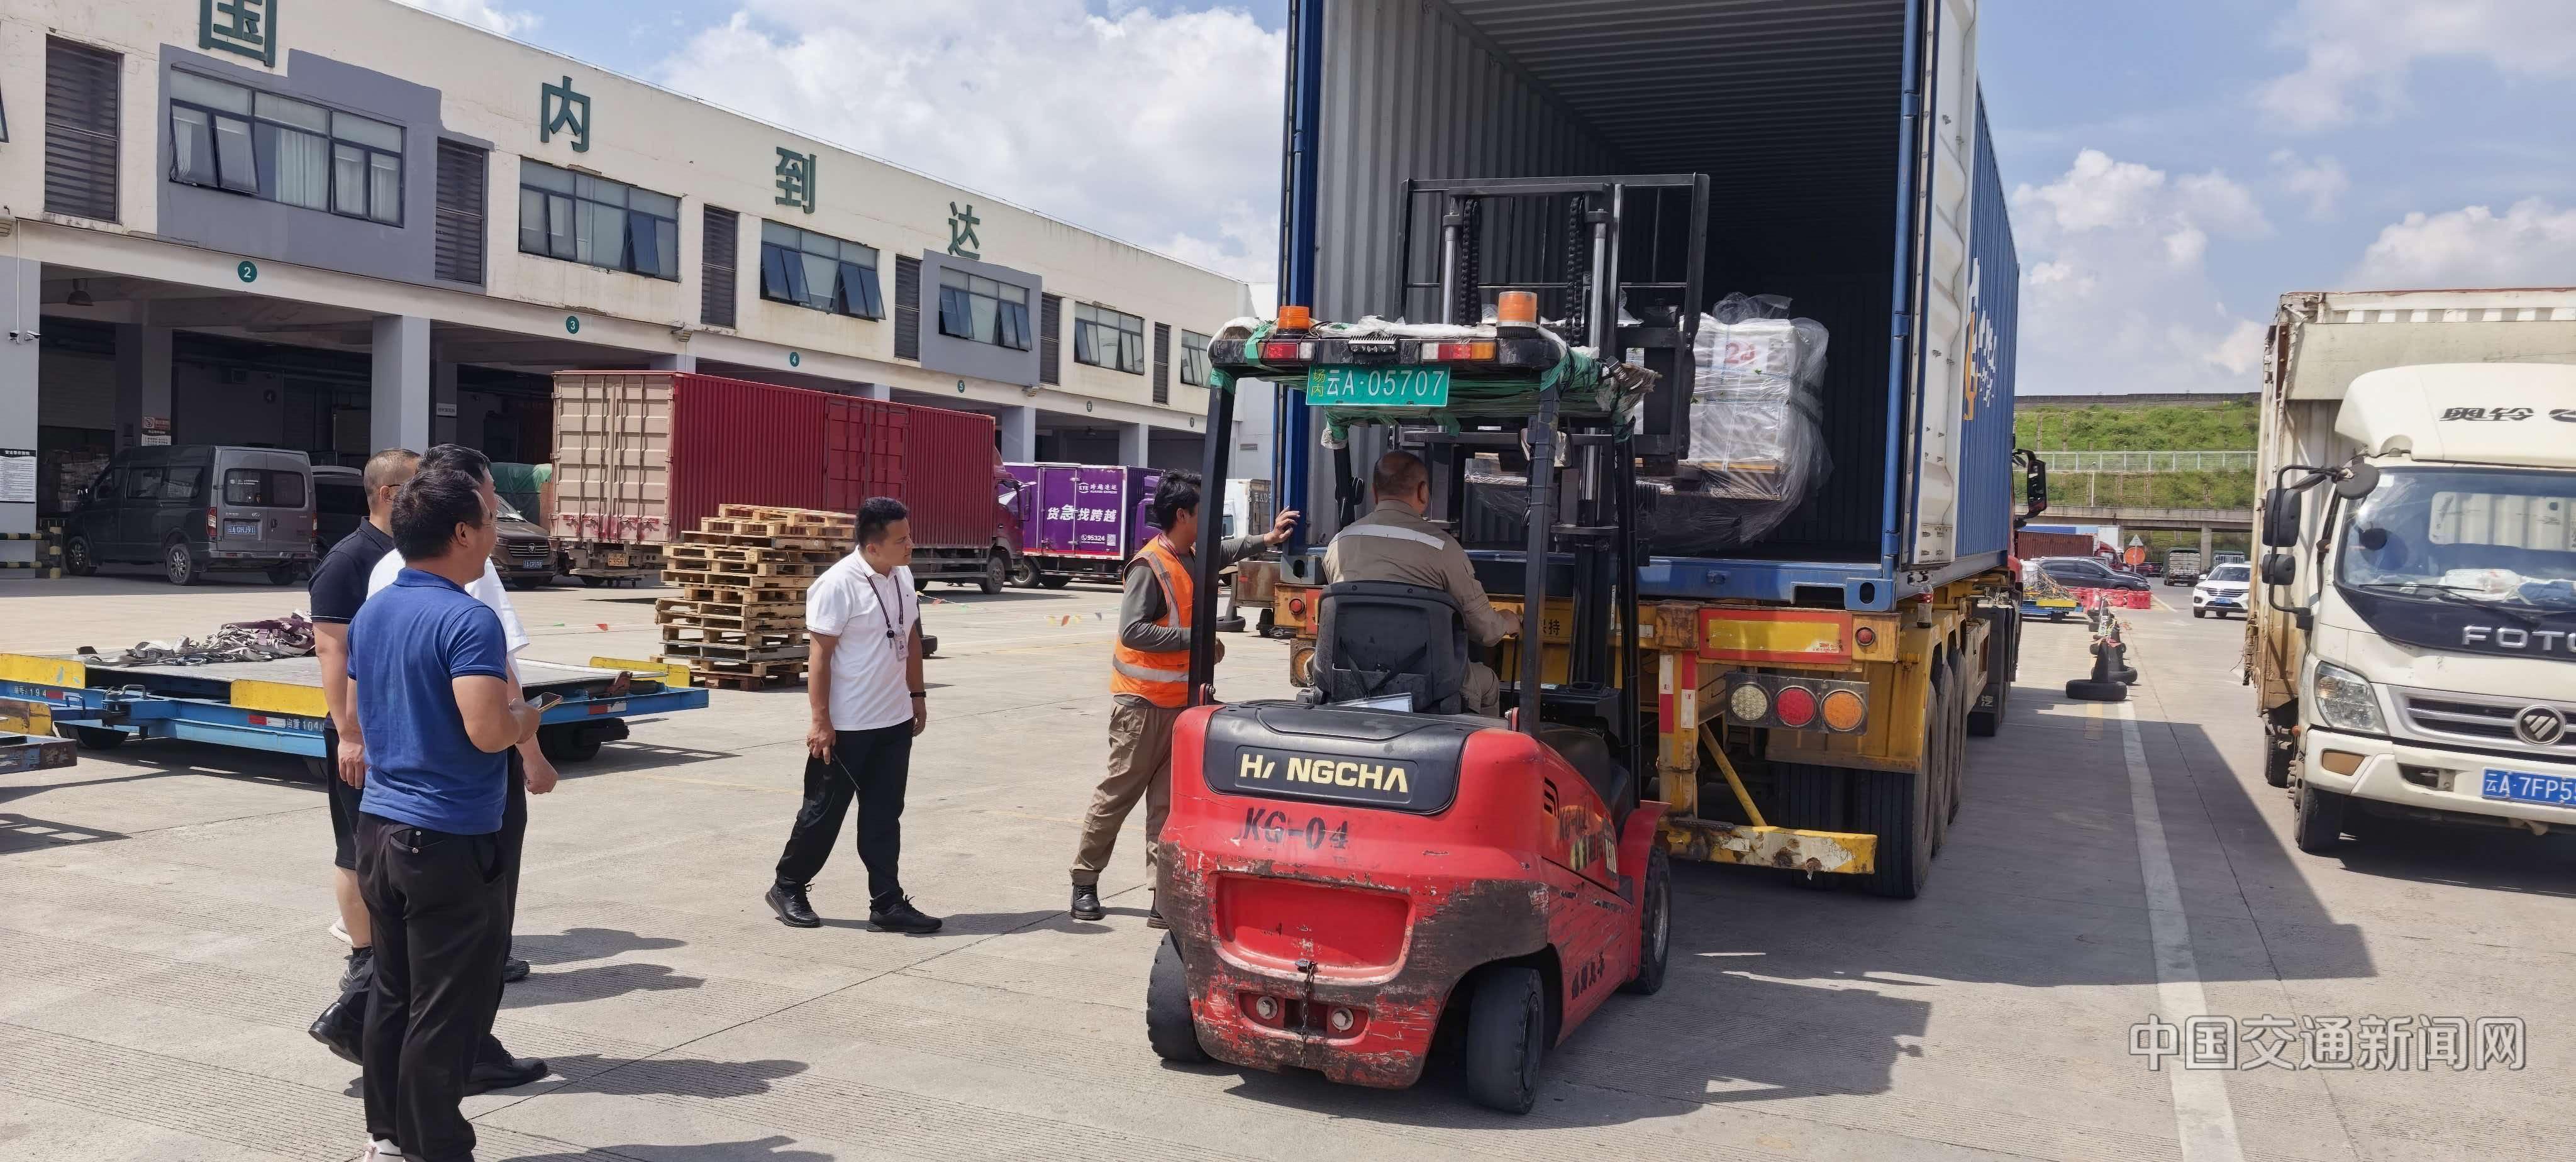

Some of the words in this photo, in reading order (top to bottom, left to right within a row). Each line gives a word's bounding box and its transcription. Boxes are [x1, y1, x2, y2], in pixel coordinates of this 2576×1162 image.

[244, 267, 252, 278] 2
[570, 321, 575, 329] 3
[1326, 369, 1445, 396] 云A·05707
[1046, 504, 1117, 523] 货急找跨越
[2462, 626, 2576, 652] FOT
[2486, 773, 2576, 800] 云A·7FP5
[1243, 807, 1348, 849] KG-04
